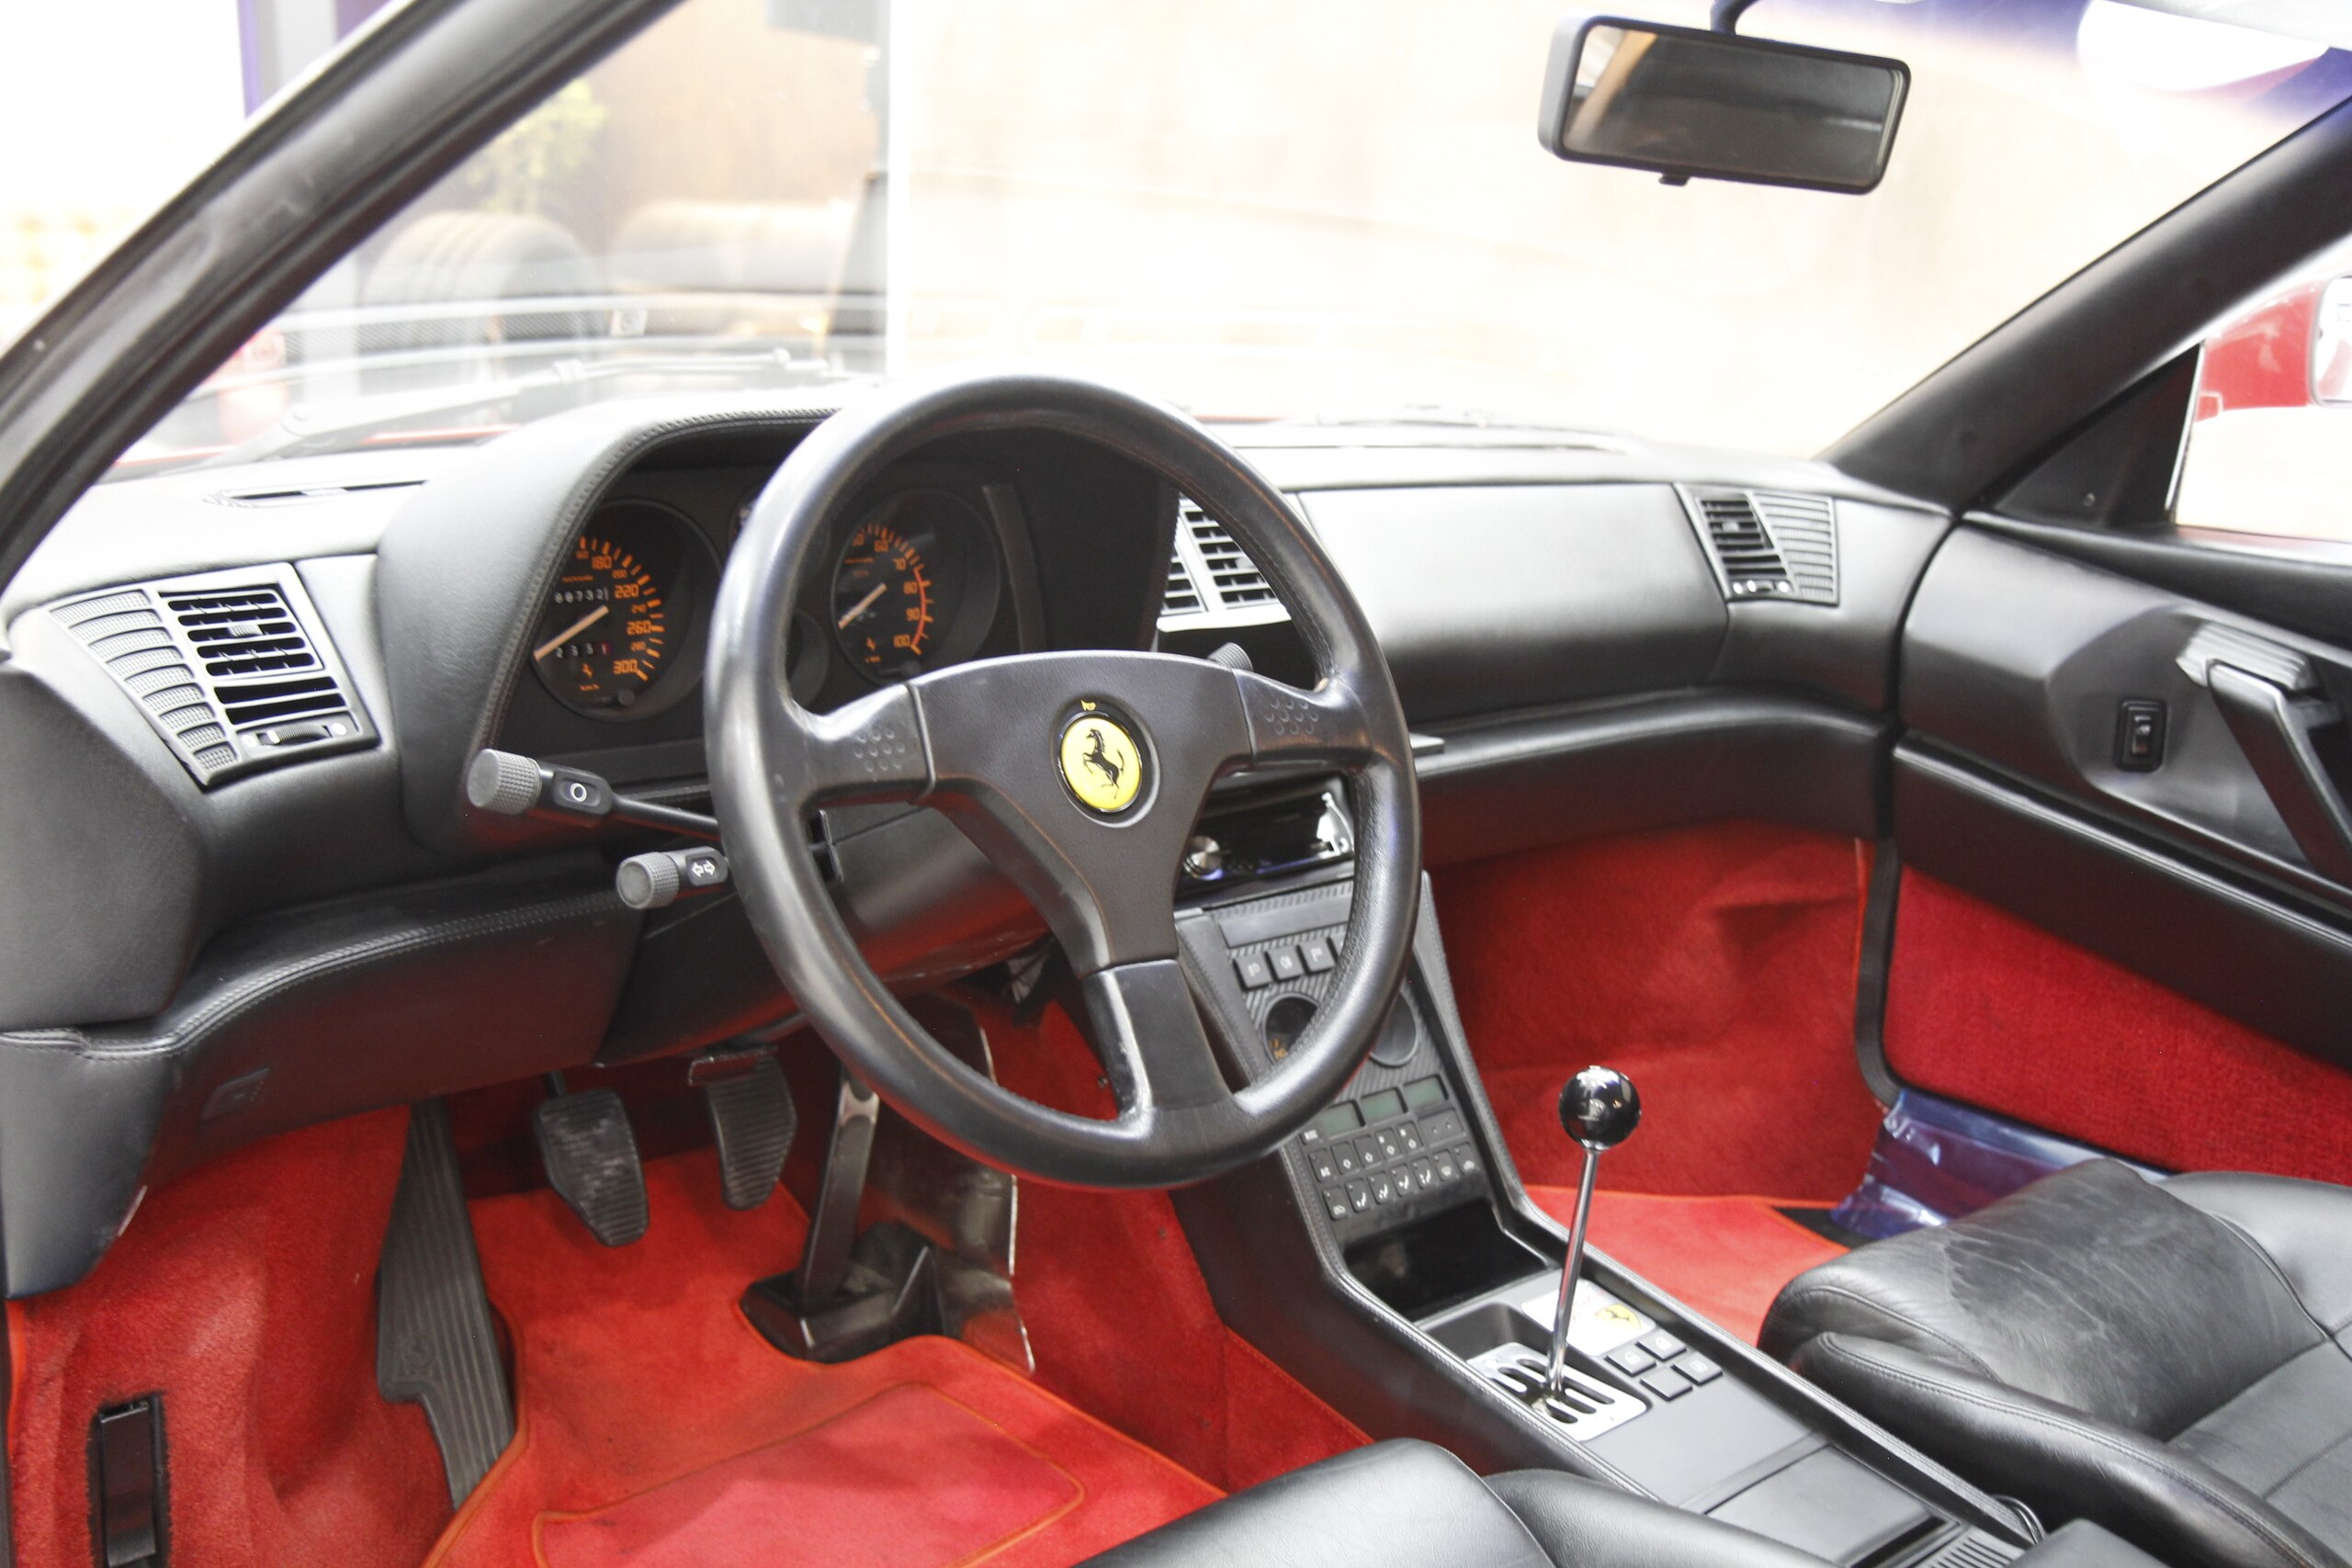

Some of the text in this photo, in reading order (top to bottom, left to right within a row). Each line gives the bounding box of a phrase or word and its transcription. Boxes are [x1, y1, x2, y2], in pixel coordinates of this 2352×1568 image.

[874, 540, 888, 552] 60
[593, 556, 612, 570] 180
[892, 558, 906, 570] 70
[615, 583, 639, 599] 220
[903, 581, 918, 594] 80
[906, 607, 921, 621] 90
[627, 620, 651, 635] 260
[893, 634, 910, 648] 100
[613, 659, 638, 674] 300
